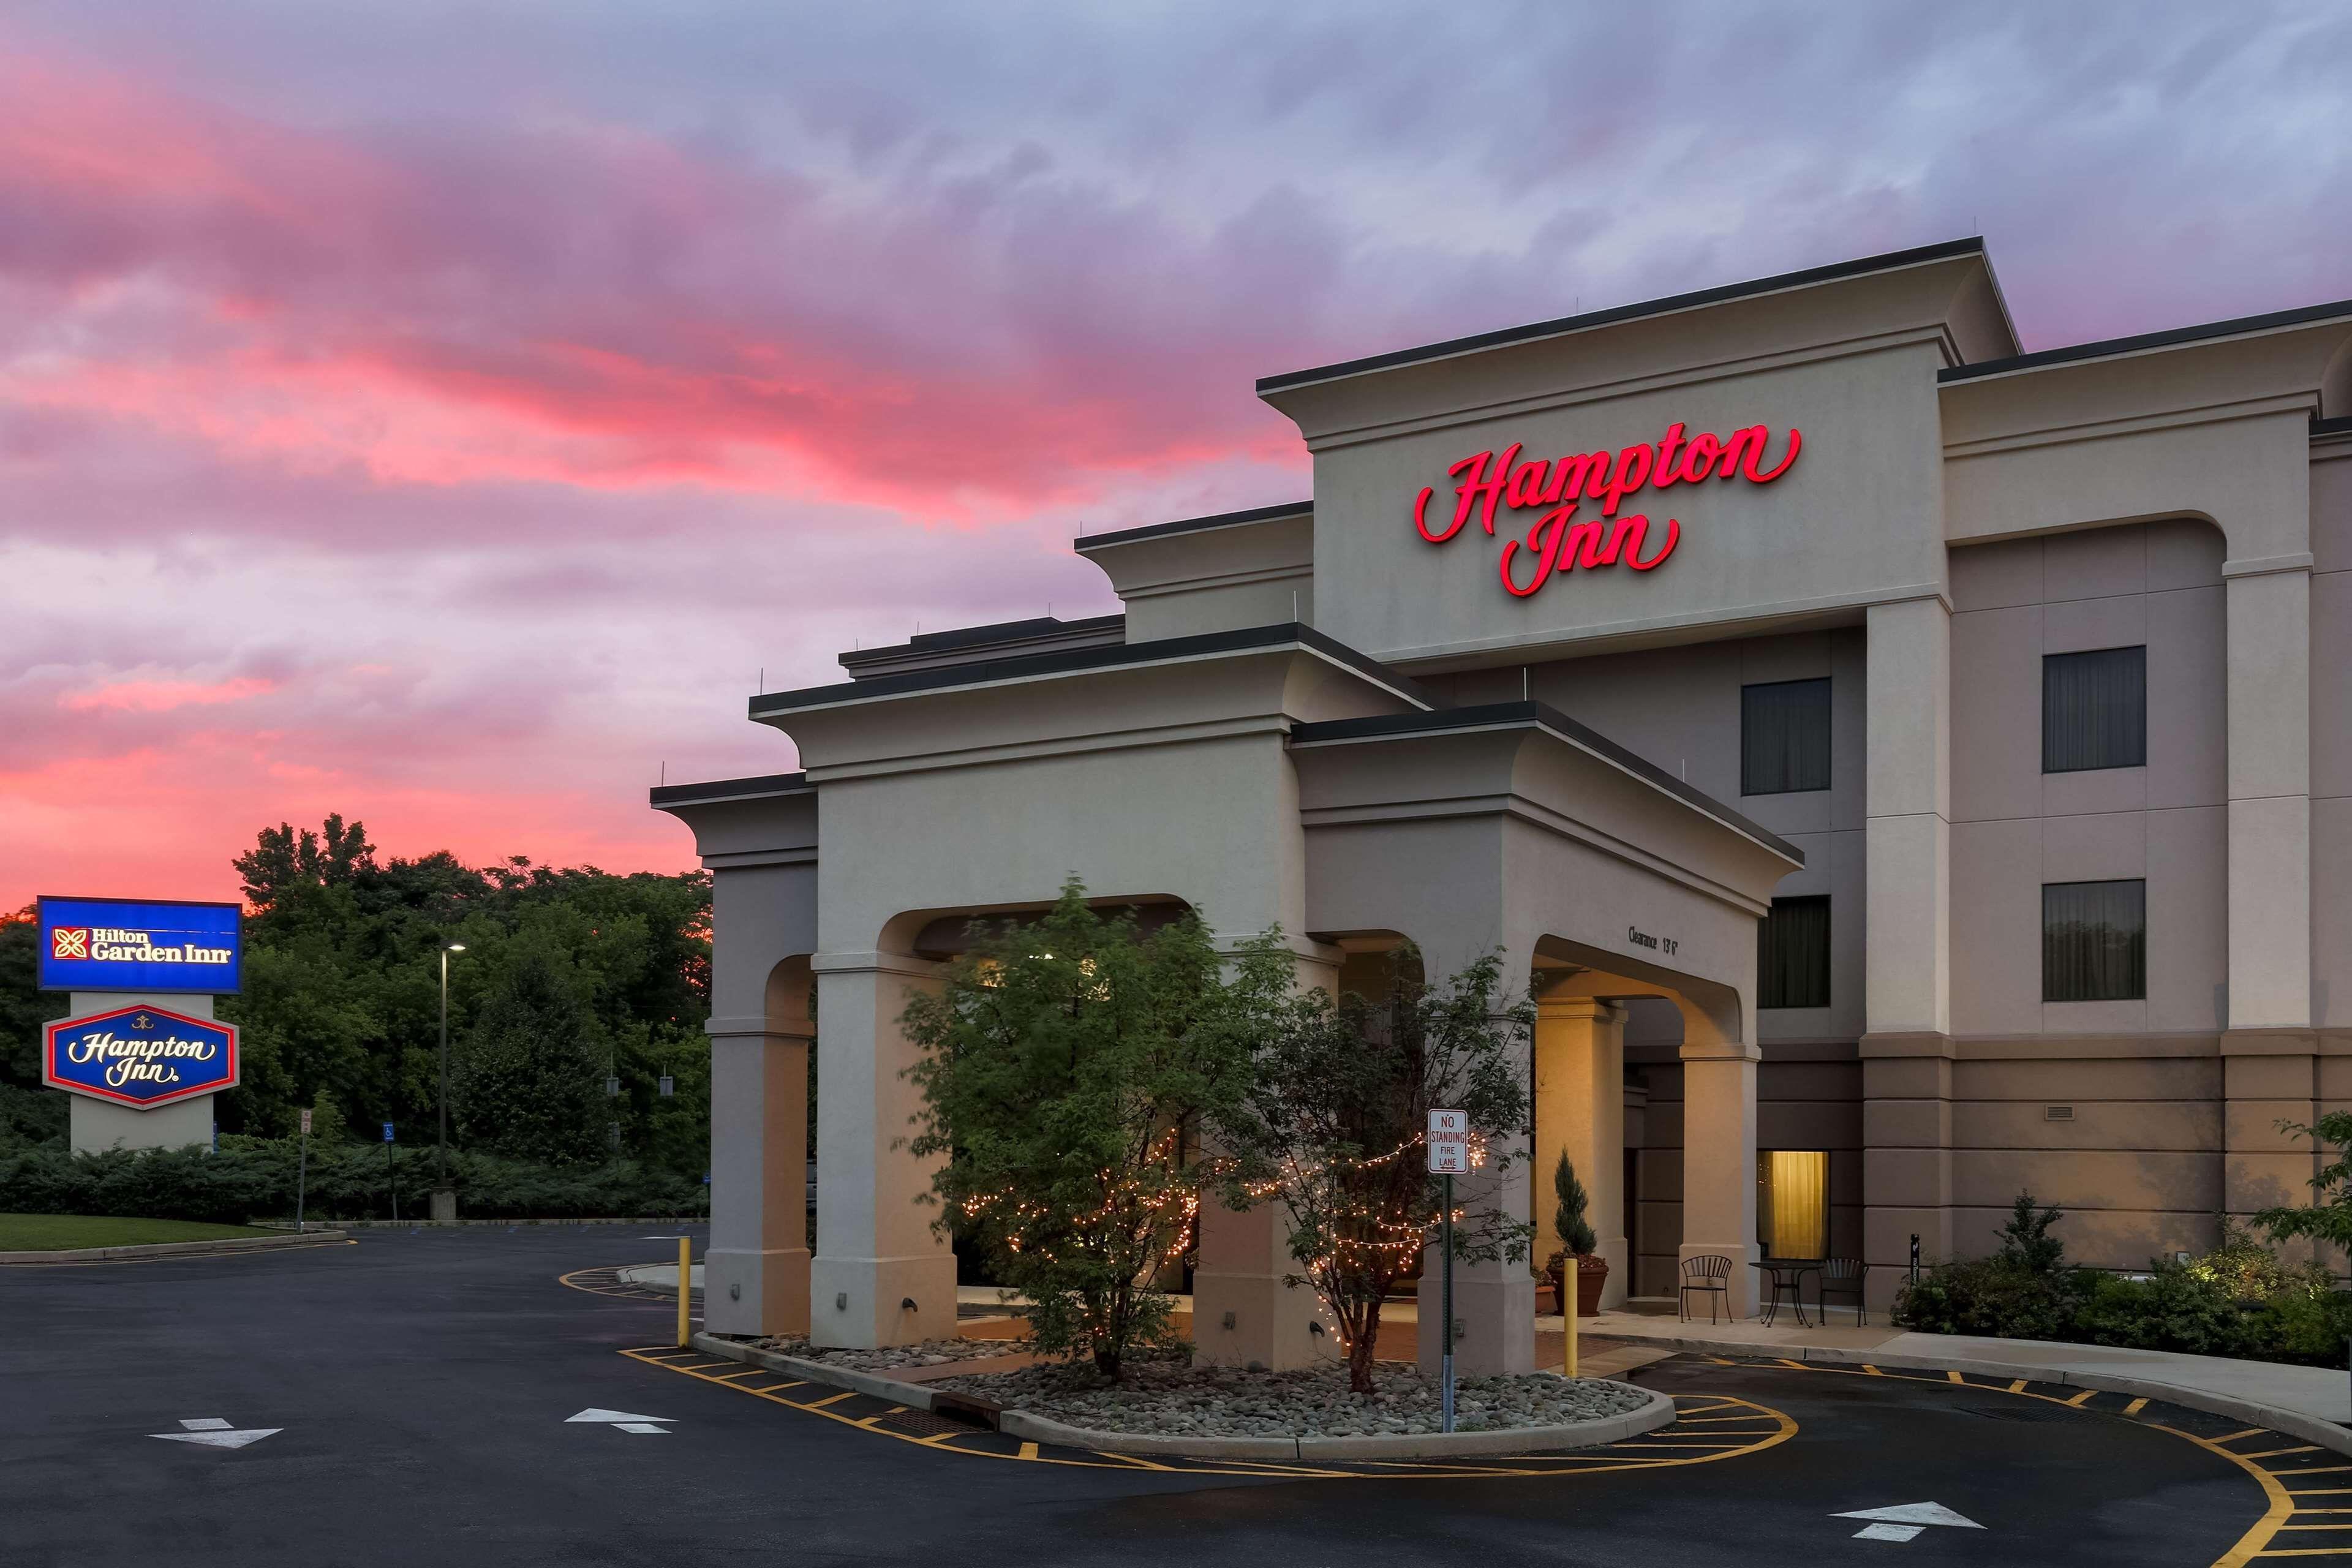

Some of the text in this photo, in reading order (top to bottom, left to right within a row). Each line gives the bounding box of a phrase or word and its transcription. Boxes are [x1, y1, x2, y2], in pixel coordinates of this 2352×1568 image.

[1415, 422, 1801, 543] Hampton
[1500, 504, 1680, 597] Inn
[92, 929, 148, 943] Hilton
[1629, 926, 1657, 949] Clearance
[91, 943, 232, 963] Garden Inn
[69, 1033, 216, 1063] Hampton
[106, 1057, 179, 1087] Inn
[1441, 1117, 1454, 1128] NO
[1431, 1131, 1464, 1144] STANDING
